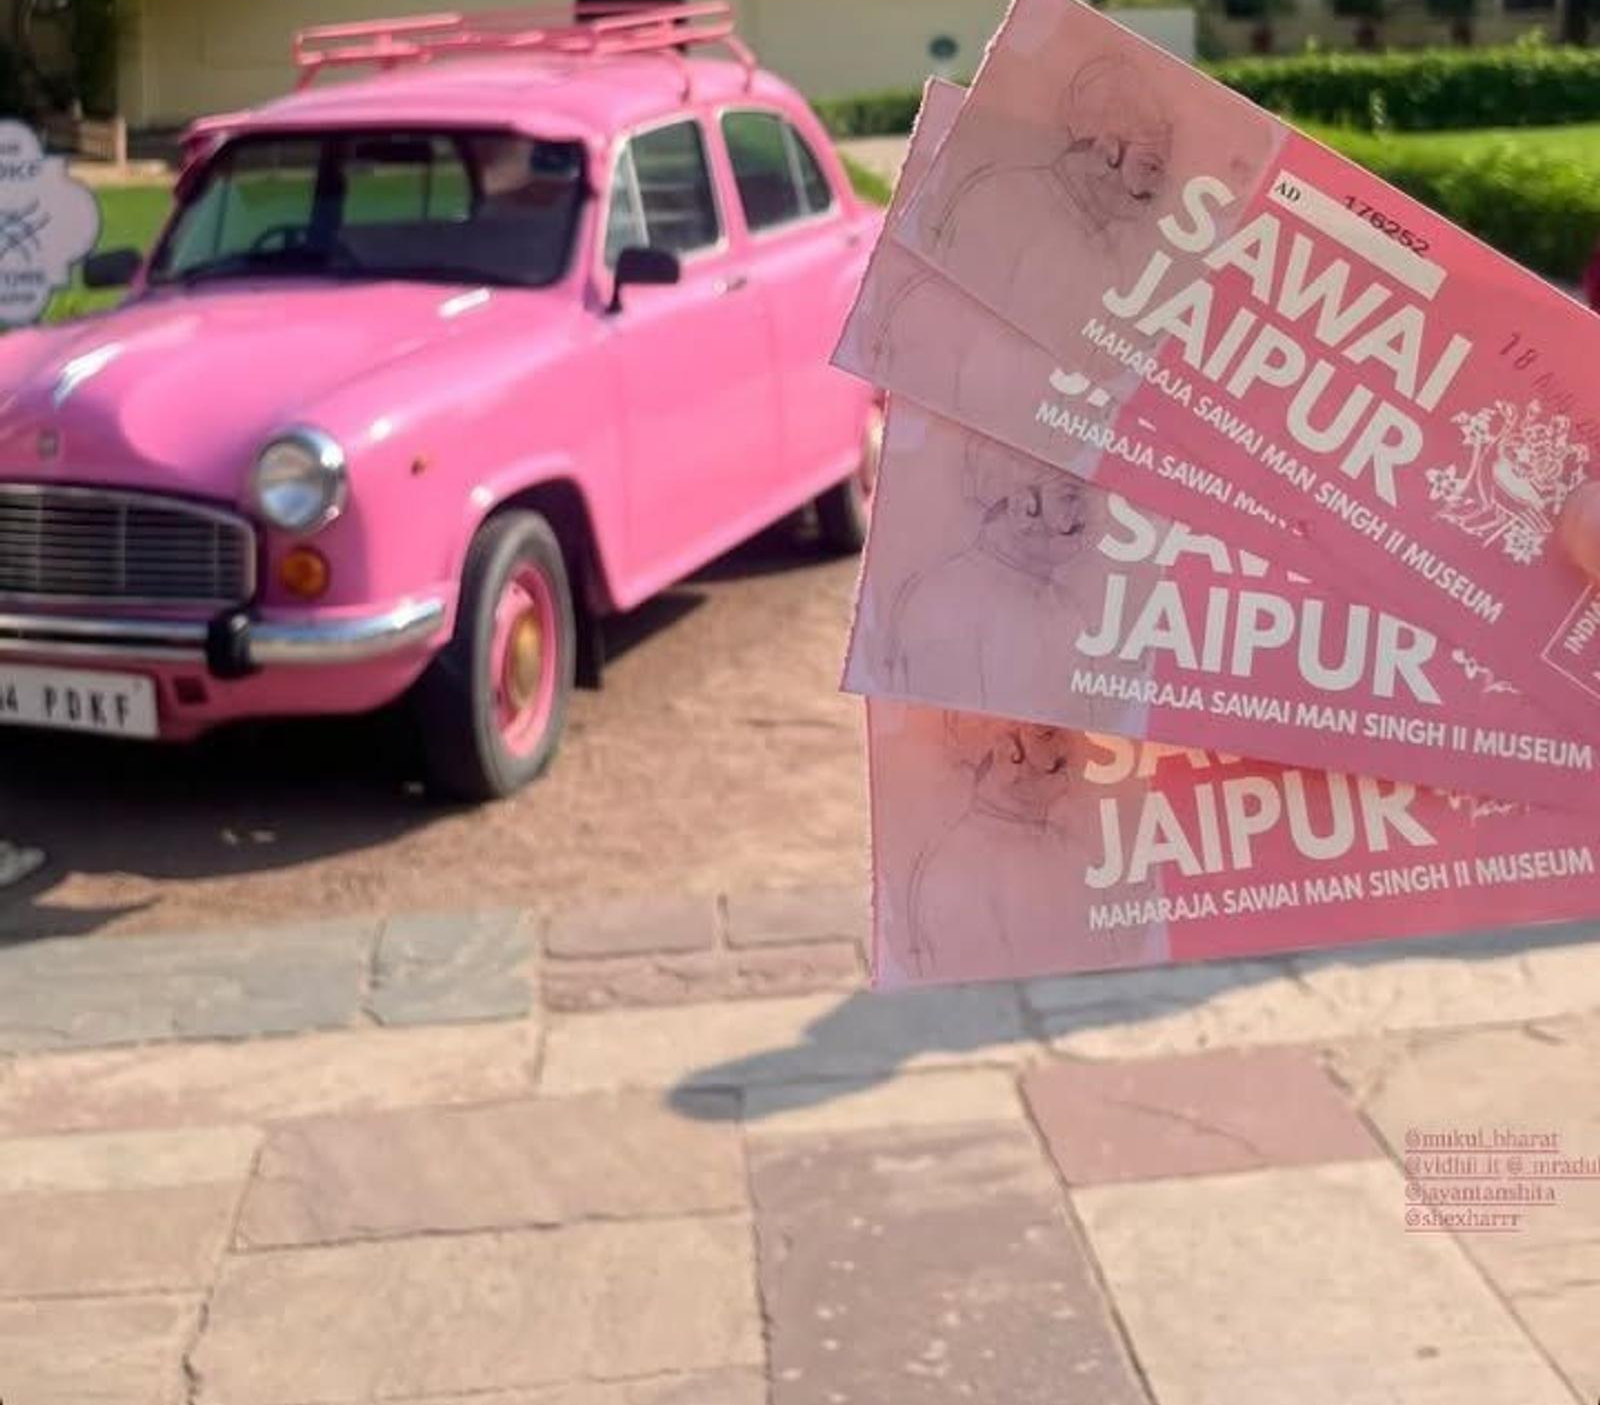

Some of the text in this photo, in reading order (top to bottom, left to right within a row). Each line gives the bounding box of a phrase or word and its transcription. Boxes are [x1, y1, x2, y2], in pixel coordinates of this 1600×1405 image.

[1275, 182, 1431, 256] AD 176252
[1157, 175, 1473, 413] SAWAI
[1101, 250, 1424, 508] JAIPUR
[1035, 401, 1233, 503] MAHARAJA SAWAI
[1081, 318, 1193, 408] MAHARAJA
[1193, 396, 1264, 455] SAWAI
[1260, 444, 1317, 492] MAN
[1314, 482, 1388, 541] SINGH
[1384, 530, 1405, 554] II
[1400, 542, 1503, 624] MUSEUM
[1075, 573, 1443, 705] JAIPUR
[45, 686, 130, 728] PDKF
[1070, 670, 1594, 770] MAHARAJA SAWAI MAN SINGH II MUSEUM
[1084, 768, 1439, 889] JAIPUR
[1089, 846, 1595, 930] MAHARAJA SAWAI MAN SINGH II MUSEUM
